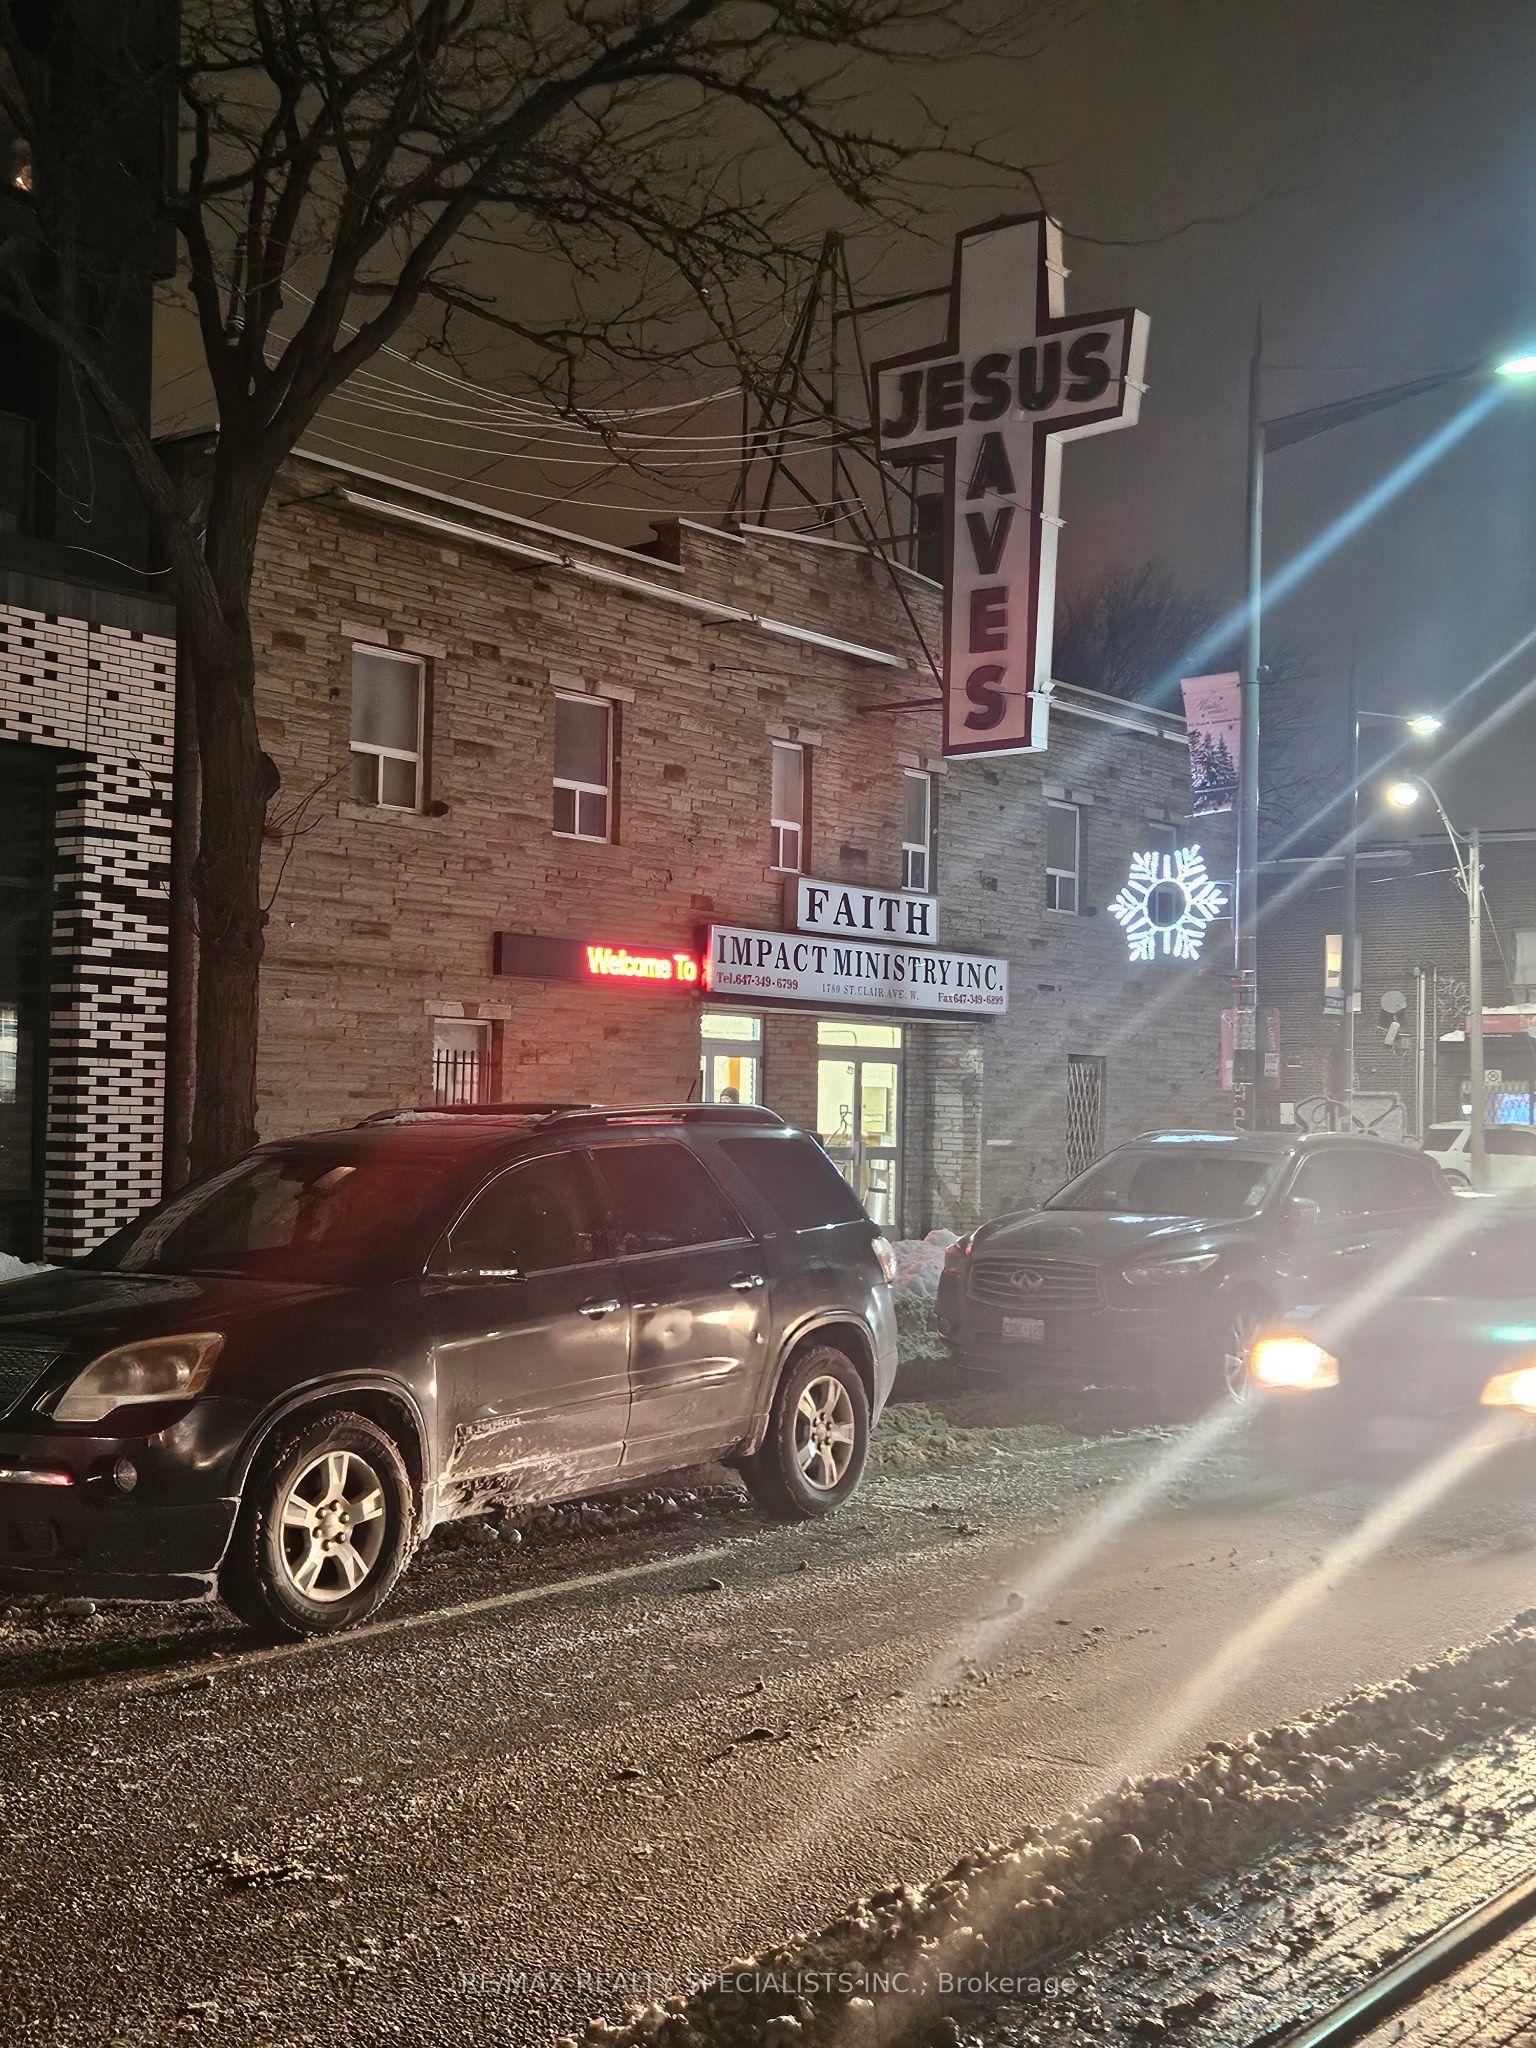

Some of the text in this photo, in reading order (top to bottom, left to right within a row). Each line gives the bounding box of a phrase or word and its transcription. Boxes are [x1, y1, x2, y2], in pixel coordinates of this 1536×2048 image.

[881, 331, 1111, 440] JESUS
[805, 887, 930, 936] FAITH
[586, 946, 697, 981] Welcome To
[717, 934, 1003, 992] IMPACT MINISTRY INC.
